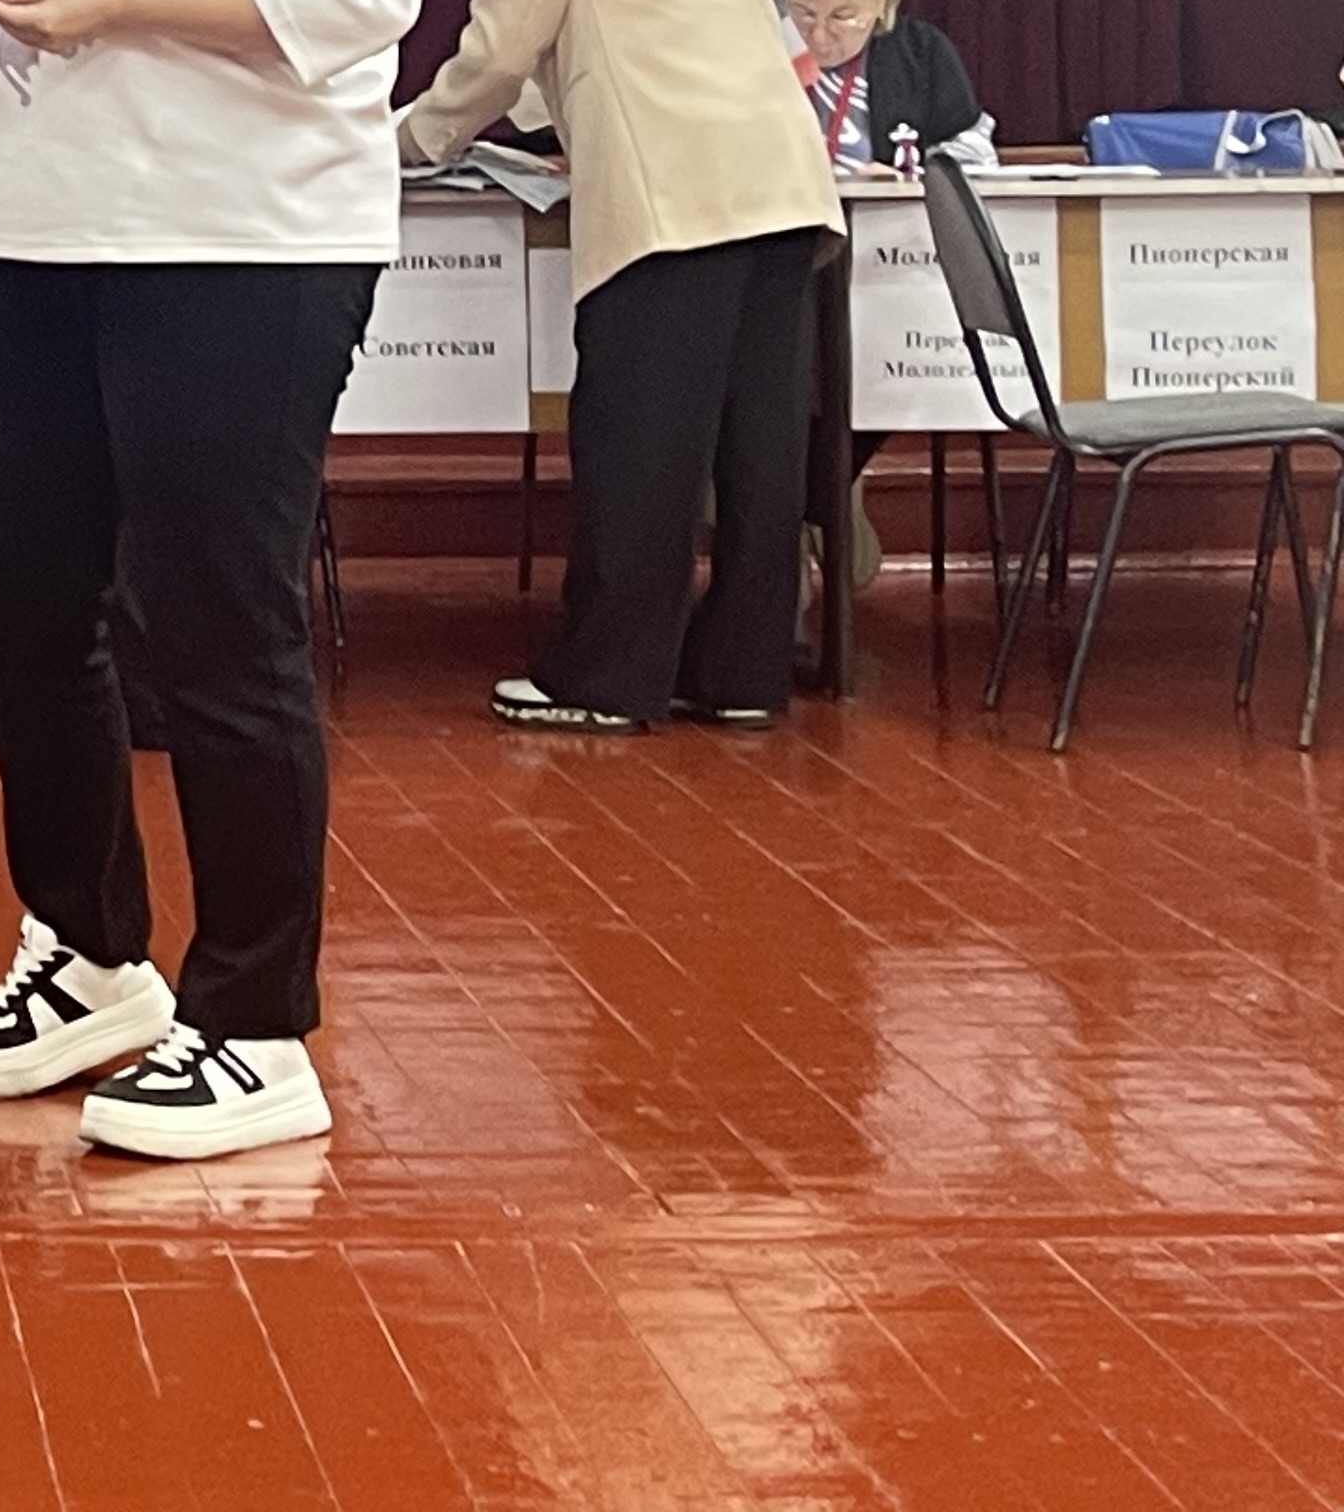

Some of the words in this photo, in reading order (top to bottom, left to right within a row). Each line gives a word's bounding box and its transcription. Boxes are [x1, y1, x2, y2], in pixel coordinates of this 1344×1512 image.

[1129, 243, 1289, 269] Пионерская
[362, 336, 495, 358] Советская
[905, 330, 1010, 352] Переок
[1149, 330, 1278, 358] Переулок
[1131, 365, 1295, 394] Пионерский
